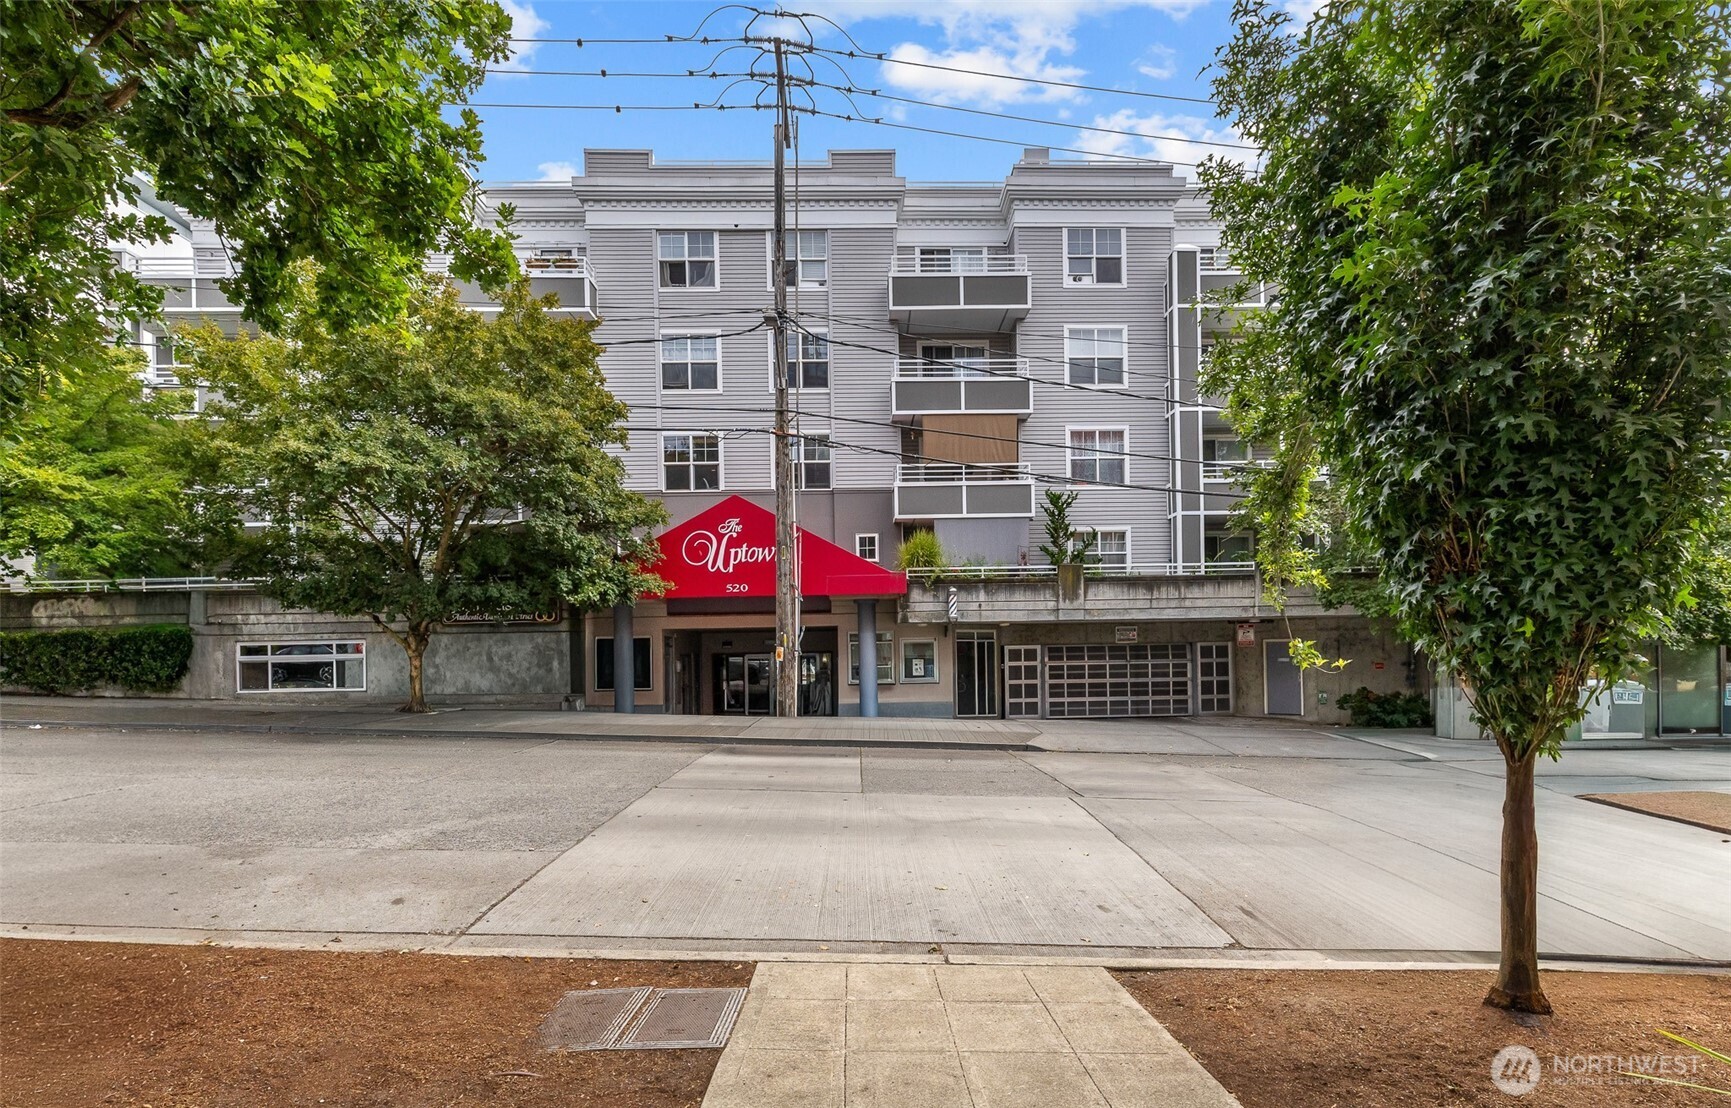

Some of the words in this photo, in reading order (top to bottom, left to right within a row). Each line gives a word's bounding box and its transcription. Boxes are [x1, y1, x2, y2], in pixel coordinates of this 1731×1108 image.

[718, 518, 743, 534] The
[682, 530, 777, 573] Uptow
[726, 583, 749, 593] 520
